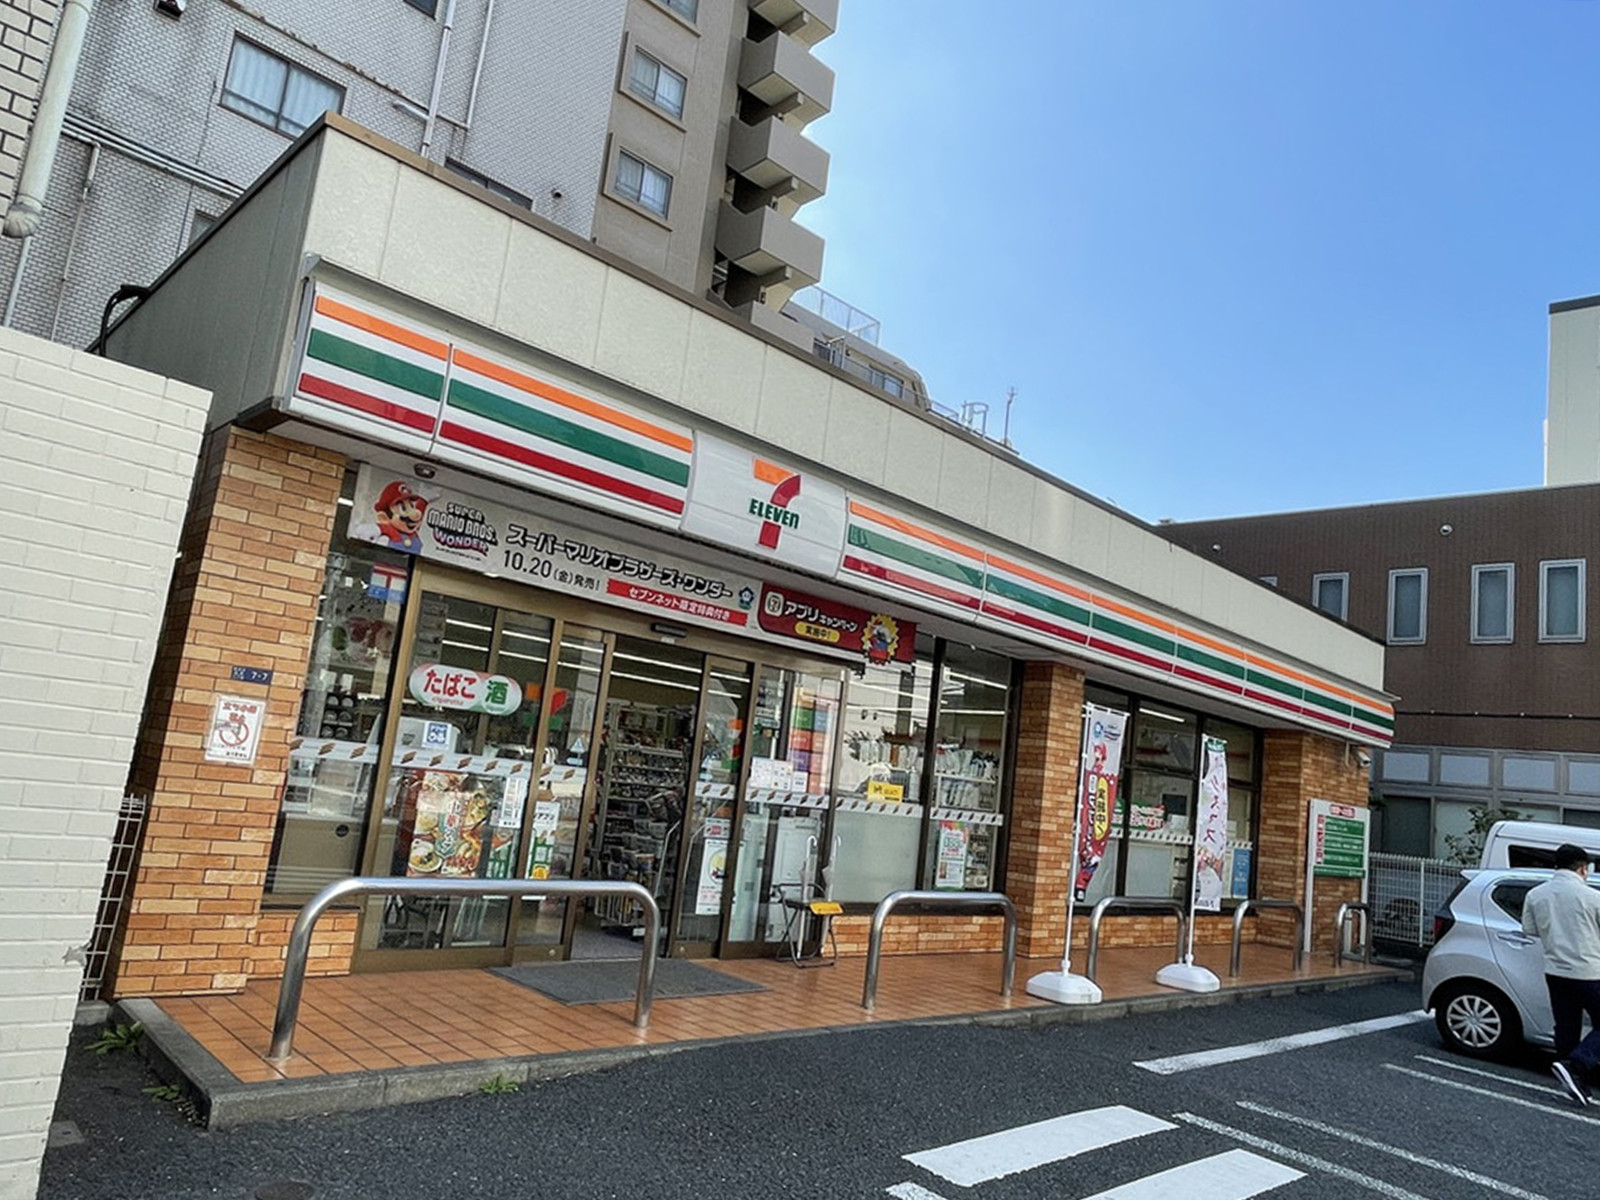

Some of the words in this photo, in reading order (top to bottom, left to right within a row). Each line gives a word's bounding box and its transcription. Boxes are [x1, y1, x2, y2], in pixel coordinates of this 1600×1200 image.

[447, 502, 484, 523] SUPER
[754, 459, 801, 549] 7
[427, 508, 466, 535] MARIO
[464, 518, 498, 545] BROS.
[433, 527, 488, 555] WONDER
[423, 670, 476, 699] たばこ
[485, 680, 509, 705] 酒
